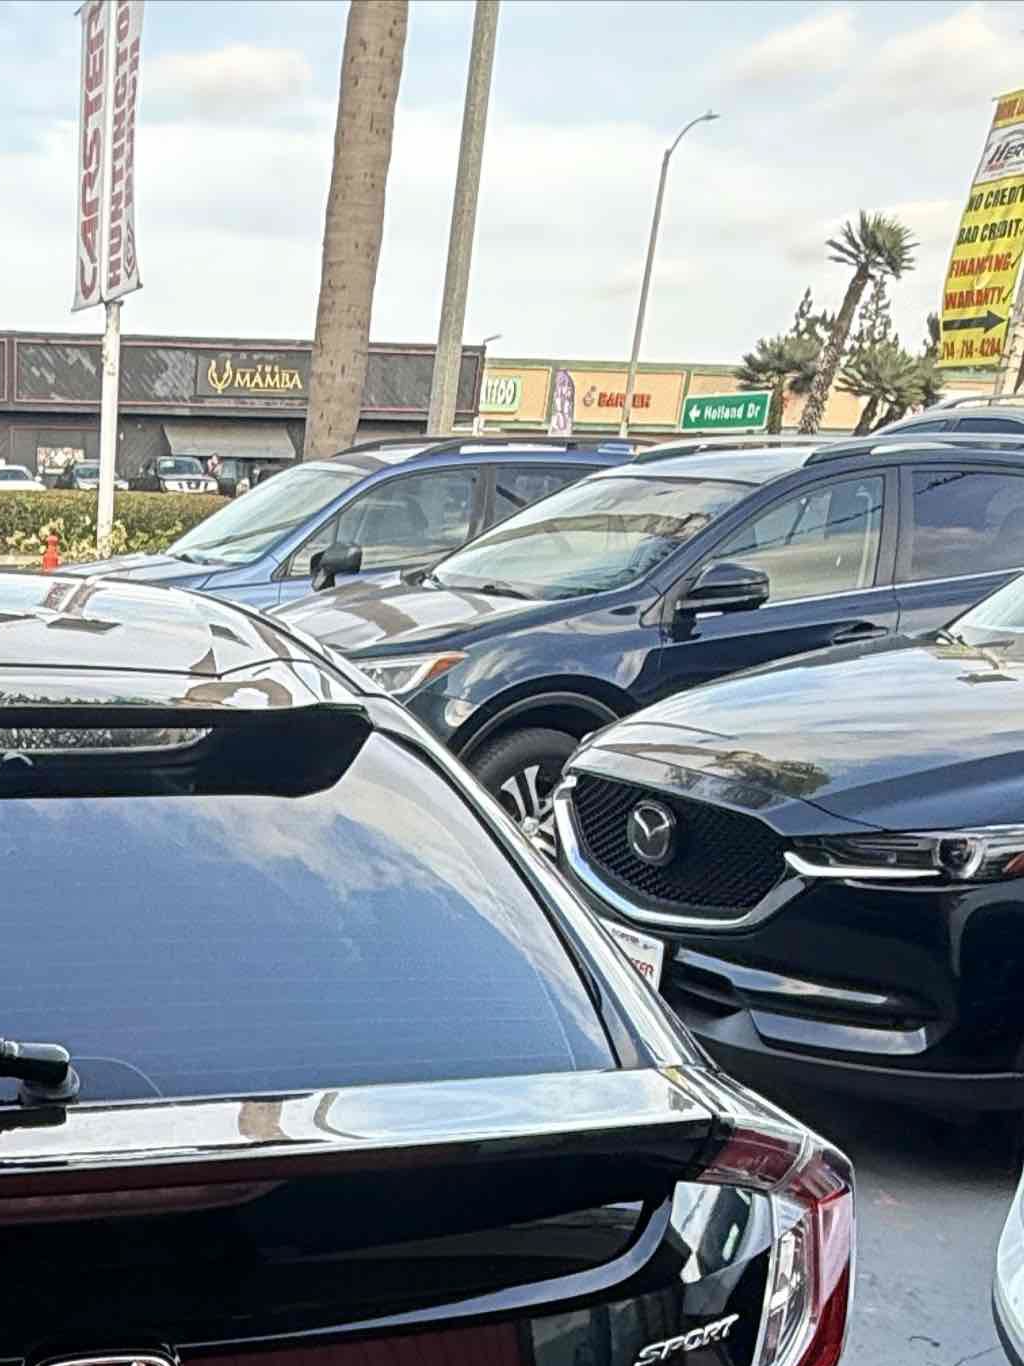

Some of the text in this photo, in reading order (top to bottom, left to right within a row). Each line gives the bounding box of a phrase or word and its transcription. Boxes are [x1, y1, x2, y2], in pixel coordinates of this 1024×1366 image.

[107, 1, 130, 289] HUNTINGTO
[235, 371, 303, 389] MAMBA
[704, 402, 760, 420] Holland Dr
